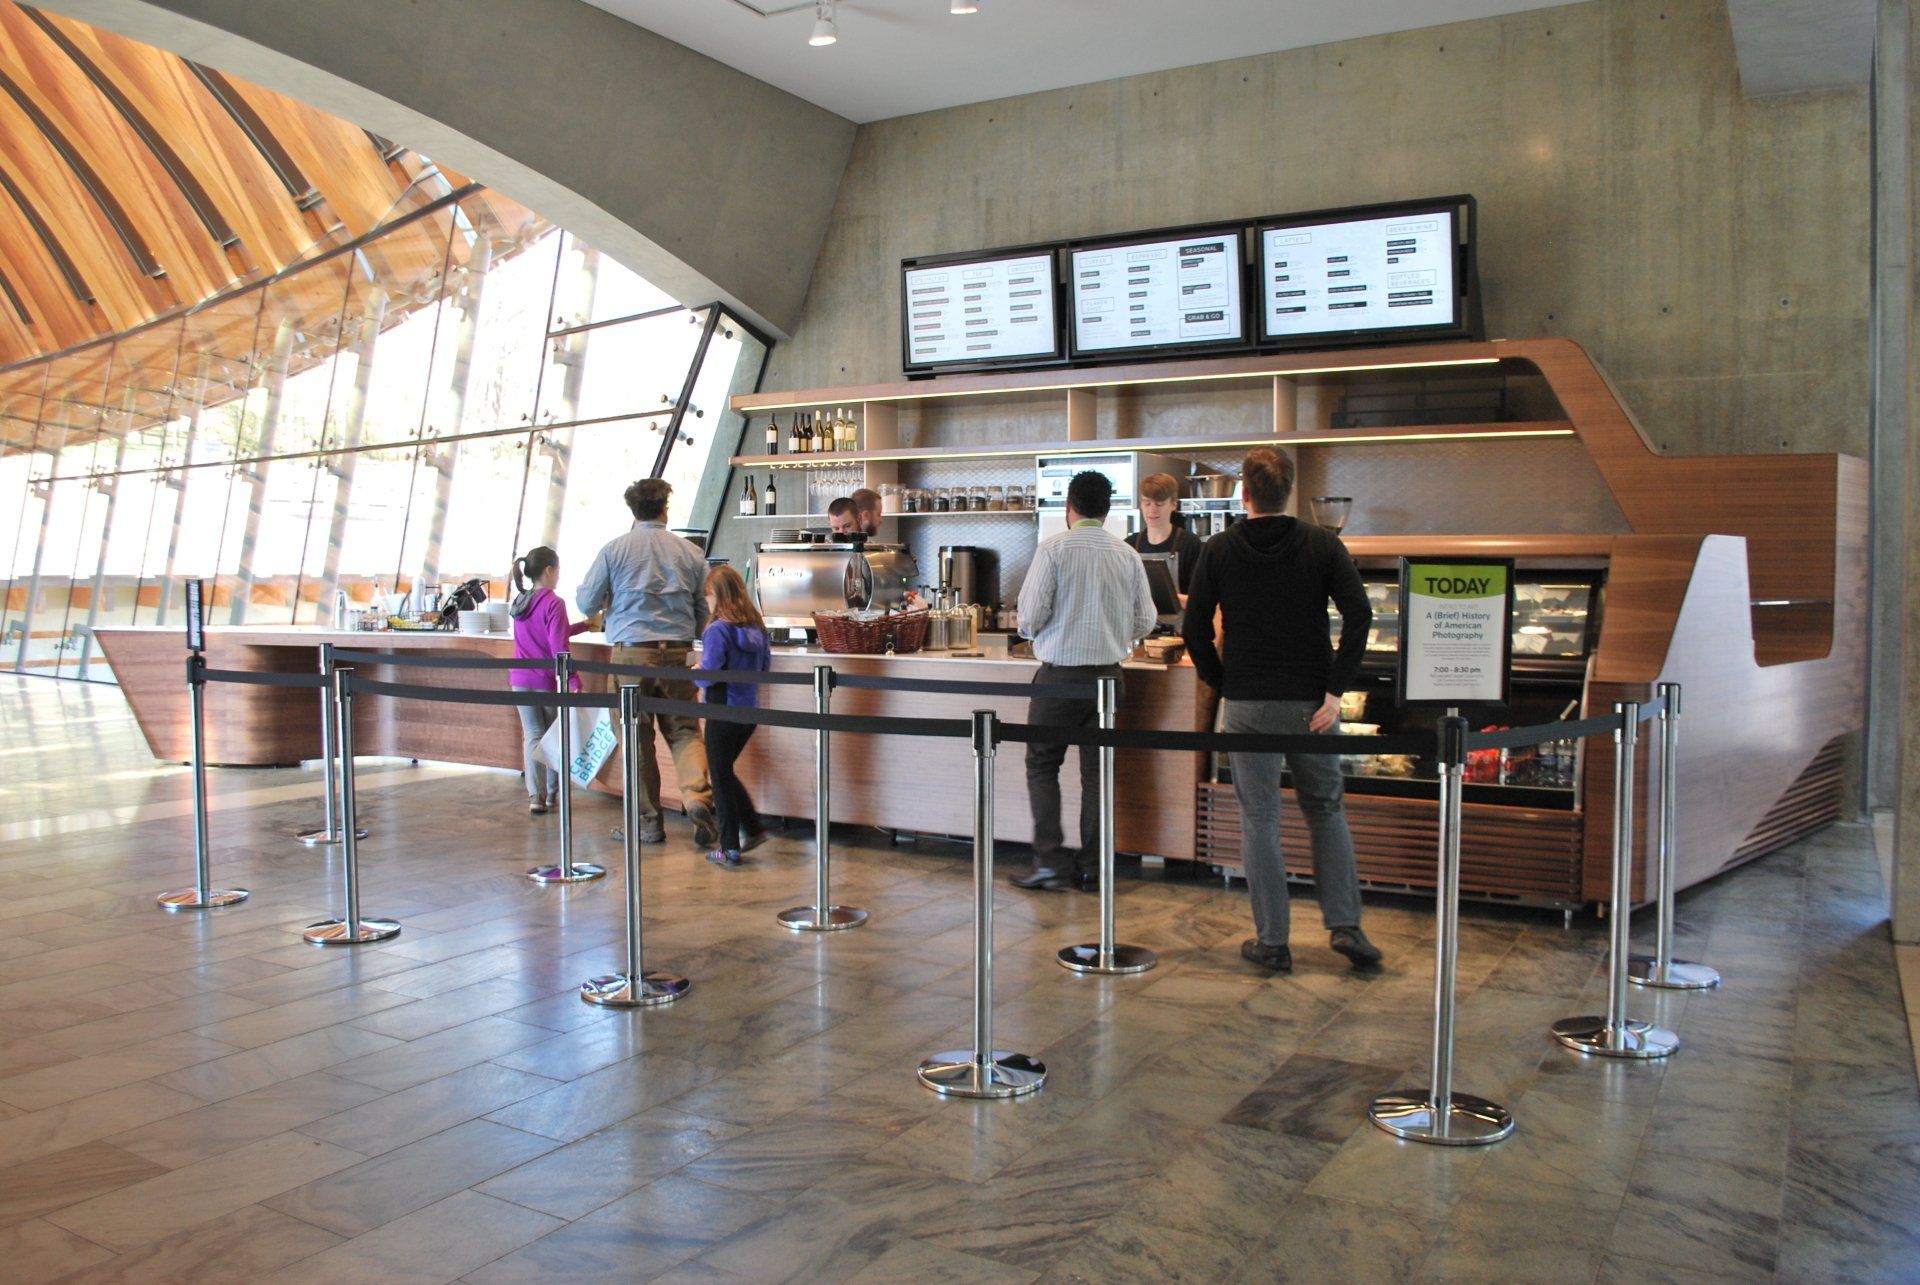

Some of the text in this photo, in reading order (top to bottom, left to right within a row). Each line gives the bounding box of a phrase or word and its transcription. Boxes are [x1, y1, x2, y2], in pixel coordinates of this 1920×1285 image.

[1185, 245, 1217, 254] SEASONAL
[1425, 577, 1490, 594] TODAY
[1434, 611, 1460, 620] (Brief)
[1462, 612, 1491, 621] History
[1432, 631, 1484, 640] Photography
[570, 720, 610, 775] CRYSTAL
[579, 729, 613, 781] BRIDGE
